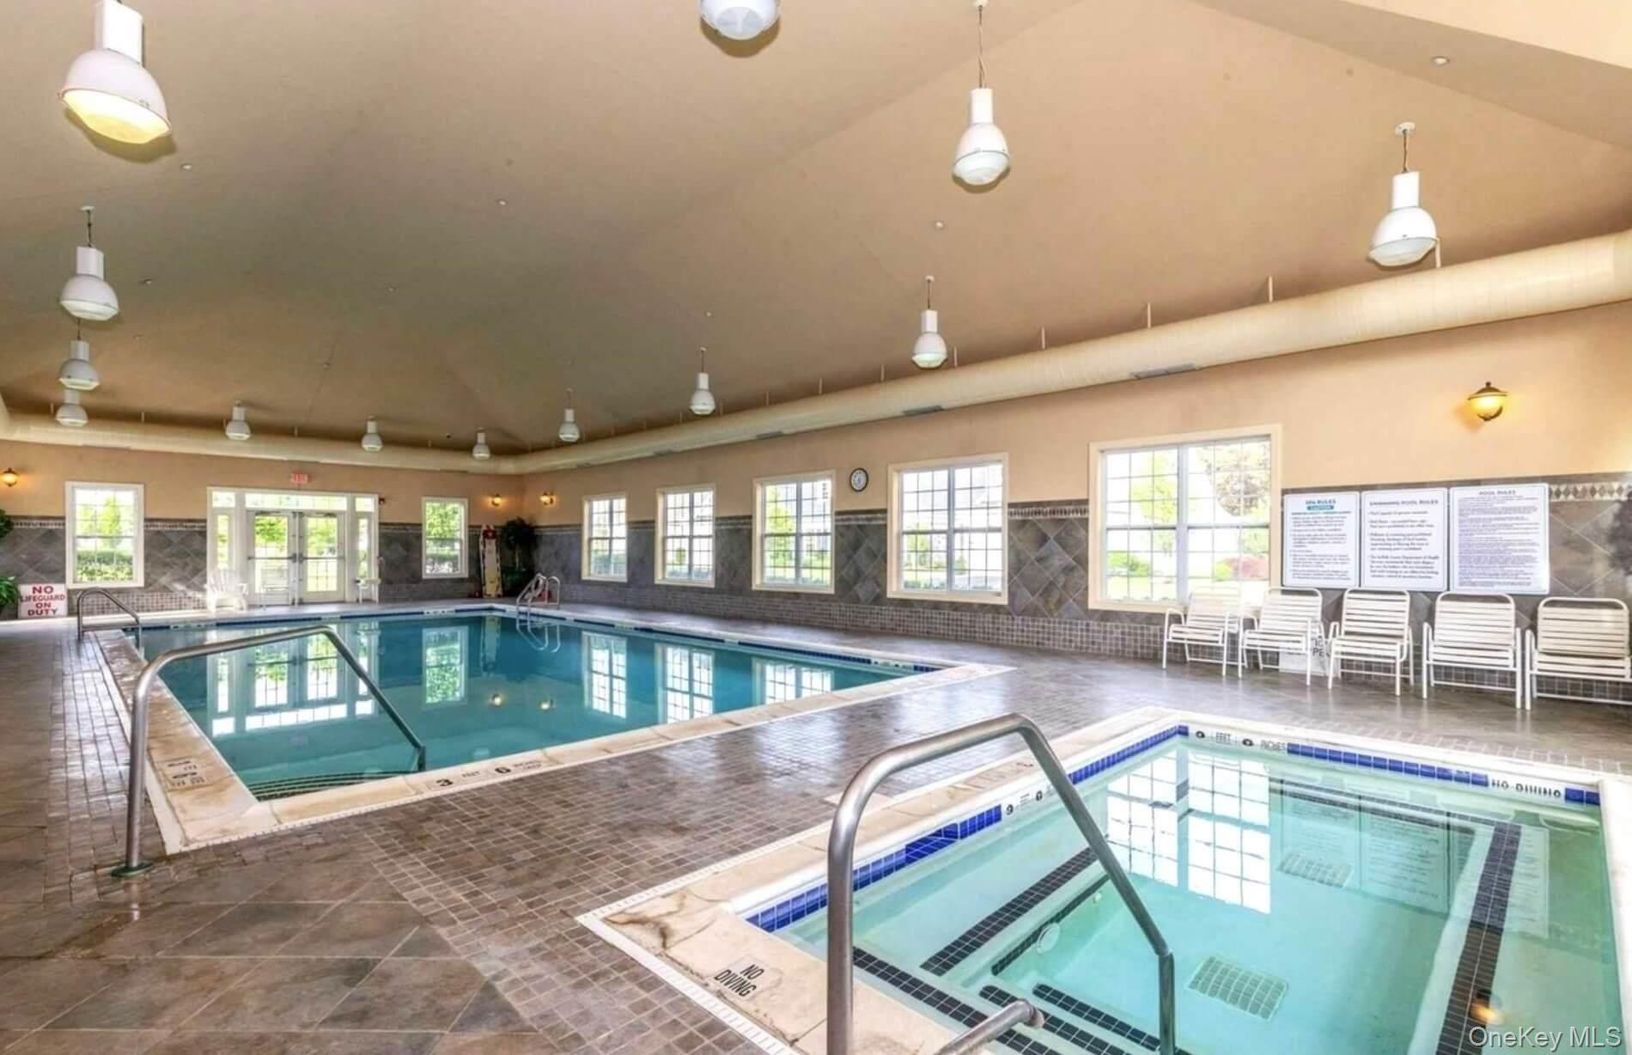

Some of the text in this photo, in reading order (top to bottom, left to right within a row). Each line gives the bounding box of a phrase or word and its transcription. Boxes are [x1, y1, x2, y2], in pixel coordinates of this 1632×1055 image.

[32, 586, 54, 594] NO
[20, 594, 66, 602] LIFEGUARD
[27, 608, 57, 616] DUTY
[435, 778, 453, 787] 3
[739, 963, 765, 980] NO
[714, 968, 757, 997] DIVING
